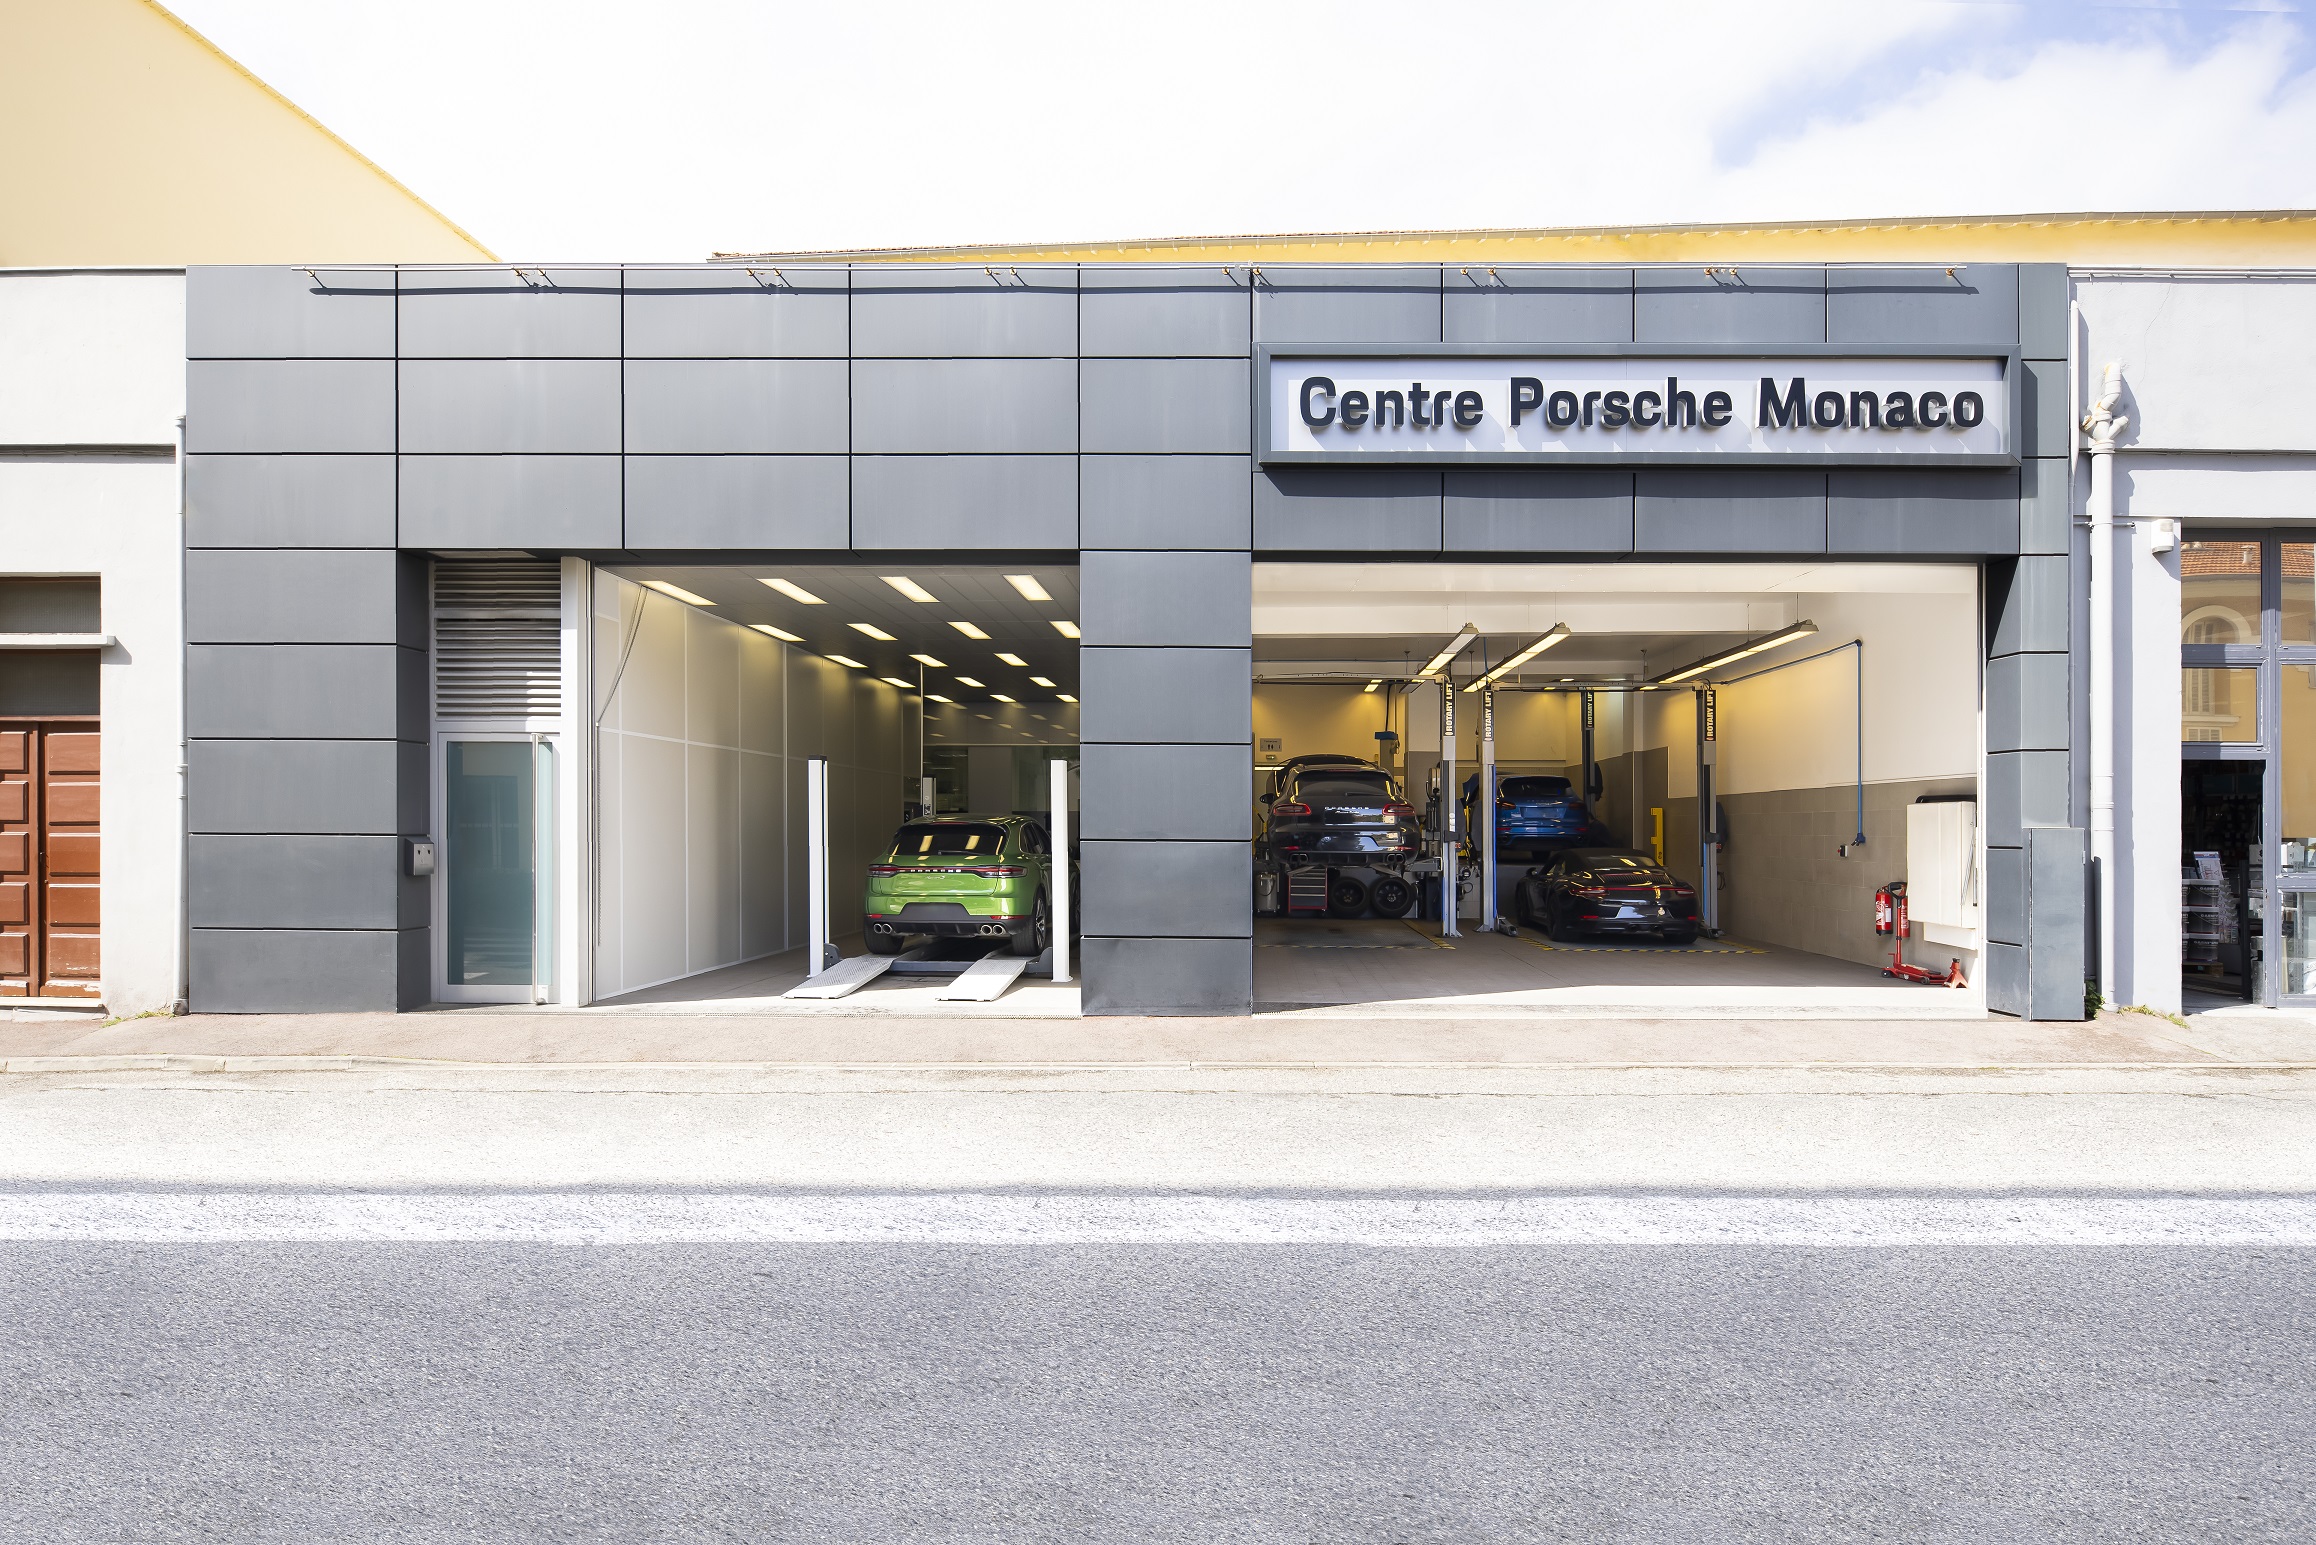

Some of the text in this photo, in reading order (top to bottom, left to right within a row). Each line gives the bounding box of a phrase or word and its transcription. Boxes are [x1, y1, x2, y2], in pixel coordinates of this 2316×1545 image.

[1299, 376, 1984, 428] Centre Porsche Monaco
[1445, 683, 1453, 731] ROTARY LIFT
[1706, 691, 1714, 706] LIFT
